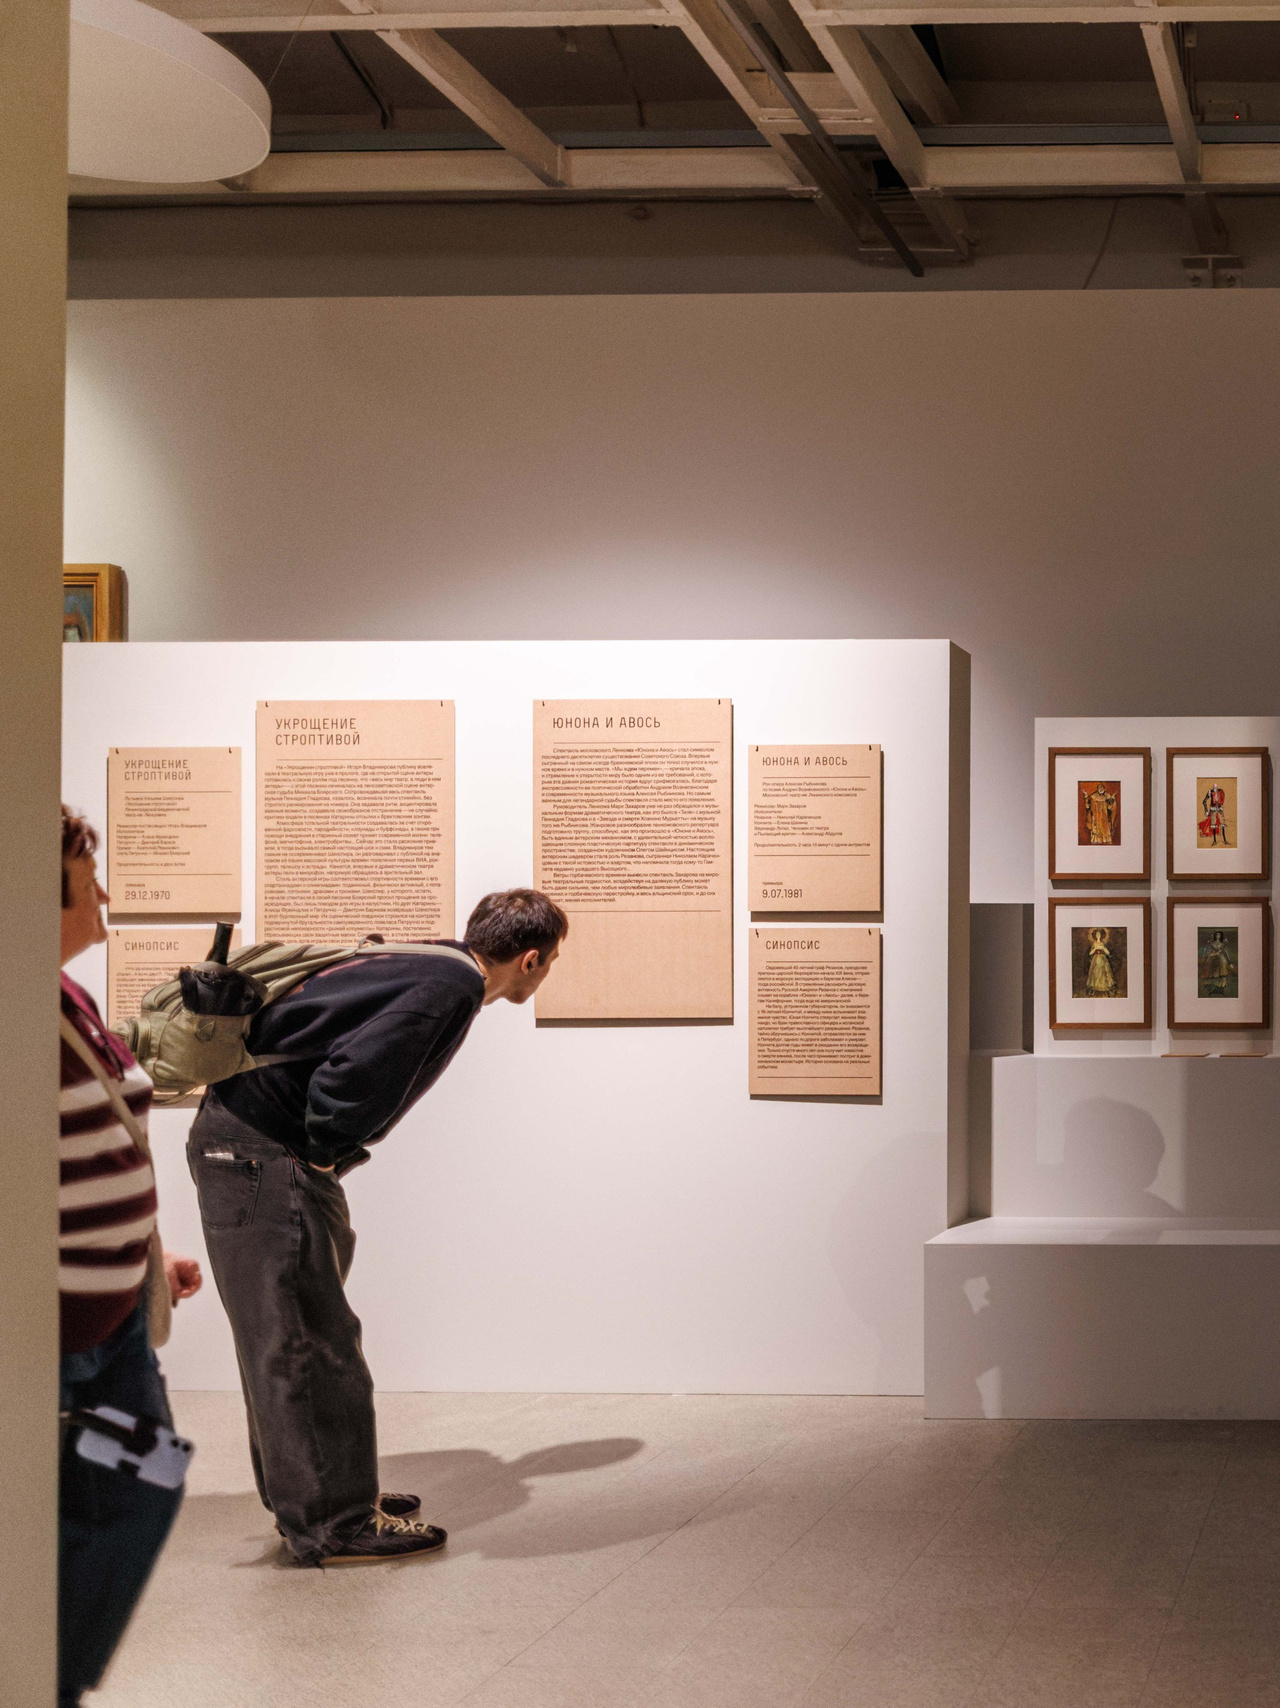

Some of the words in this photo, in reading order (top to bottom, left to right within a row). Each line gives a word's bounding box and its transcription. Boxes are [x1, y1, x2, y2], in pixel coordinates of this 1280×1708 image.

[276, 718, 357, 730] УКРОЩЕНИЕ
[553, 717, 599, 728] ЮНОНА
[606, 717, 613, 728] И
[619, 716, 661, 728] АВОСЬ
[276, 731, 360, 745] СТРОПТИВОЙ
[124, 760, 188, 769] УКРОЩЕНИЕ
[762, 756, 799, 766] ЮНОНА
[804, 756, 811, 766] И
[815, 756, 848, 766] АВОСЬ
[124, 770, 192, 780] СТРОПТИВОЙ
[124, 890, 170, 900] 29.12.1970
[762, 889, 803, 898] 9.07.1981
[124, 942, 179, 950] СИНОПСИС
[766, 940, 820, 950] СИНОПСИС
